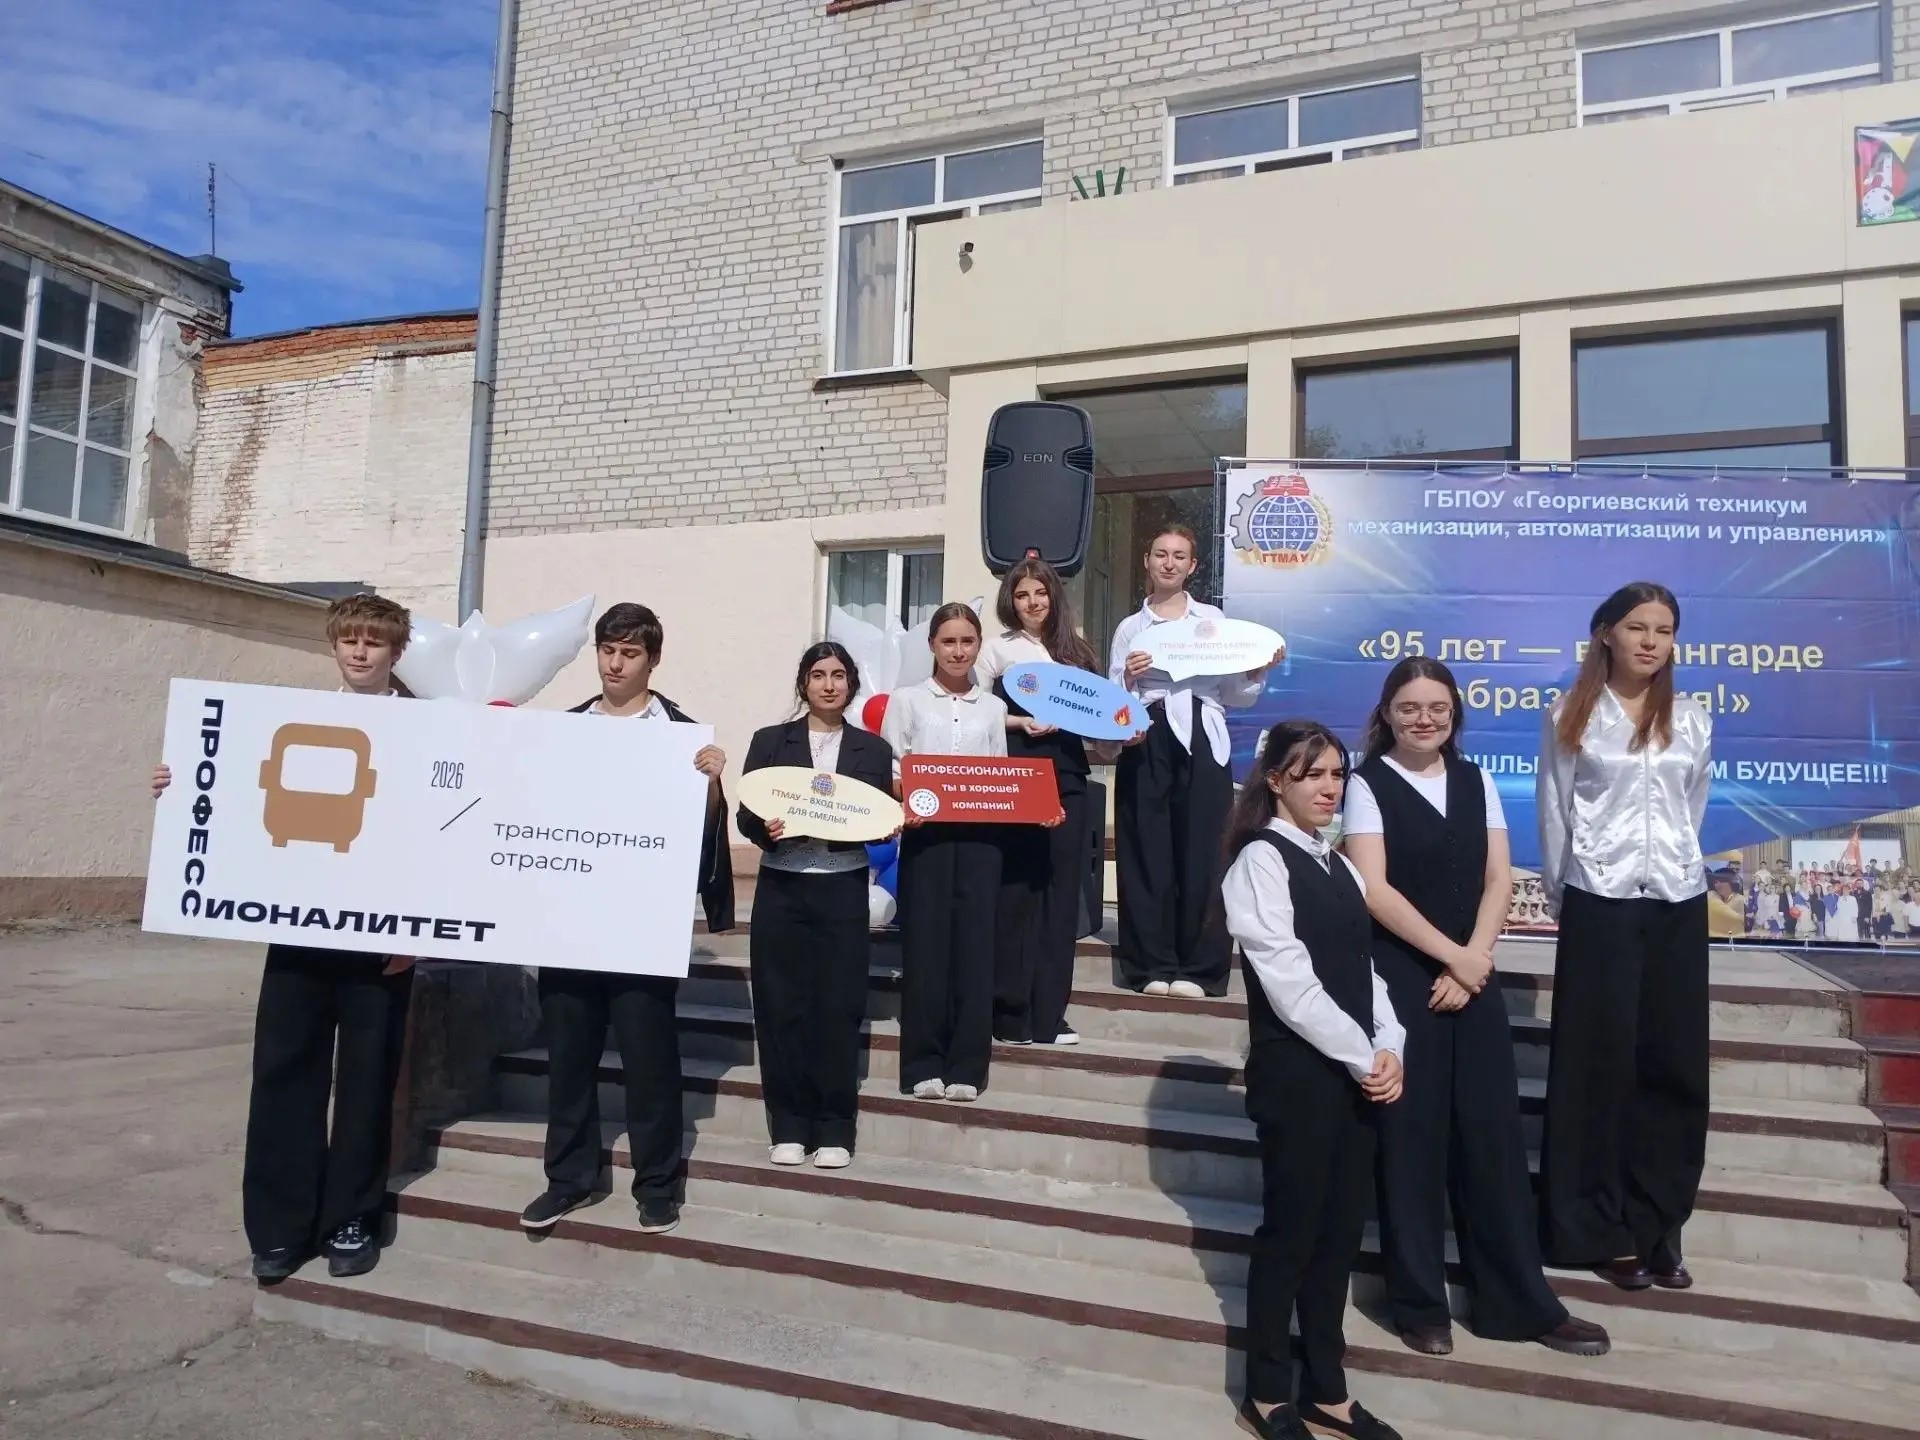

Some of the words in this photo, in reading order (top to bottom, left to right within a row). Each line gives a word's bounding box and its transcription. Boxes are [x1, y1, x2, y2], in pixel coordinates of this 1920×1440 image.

[1023, 453, 1053, 463] EON
[1424, 489, 1505, 508] ГБПОУ
[1513, 490, 1689, 513] «Георгиевский
[1696, 497, 1807, 517] техникум
[1348, 520, 1510, 538] механизации,
[1517, 520, 1700, 541] автоматизации
[1708, 526, 1721, 539] и
[1730, 527, 1886, 544] управления»
[1262, 553, 1309, 563] ГТМАУ
[1358, 630, 1424, 660] «95
[1437, 636, 1507, 662] лет
[1059, 679, 1099, 698] ГТМАУ-
[1048, 694, 1093, 715] готовим
[431, 761, 464, 789] 2026
[912, 764, 1034, 777] ПРОФЕССИОНАЛИТЕТ
[1736, 760, 1888, 790] БУДУЩЕЕ!!!
[969, 784, 1019, 793] хорошей
[772, 788, 800, 801] ГТМАУ
[809, 796, 834, 809] ВХОД
[836, 802, 871, 816] ТОЛЬКО
[952, 800, 1015, 811] компании!
[787, 806, 807, 816] ДЛЯ
[809, 810, 848, 825] СМЕЛЫХ
[494, 823, 665, 849] транспортная
[491, 852, 592, 873] отрасль
